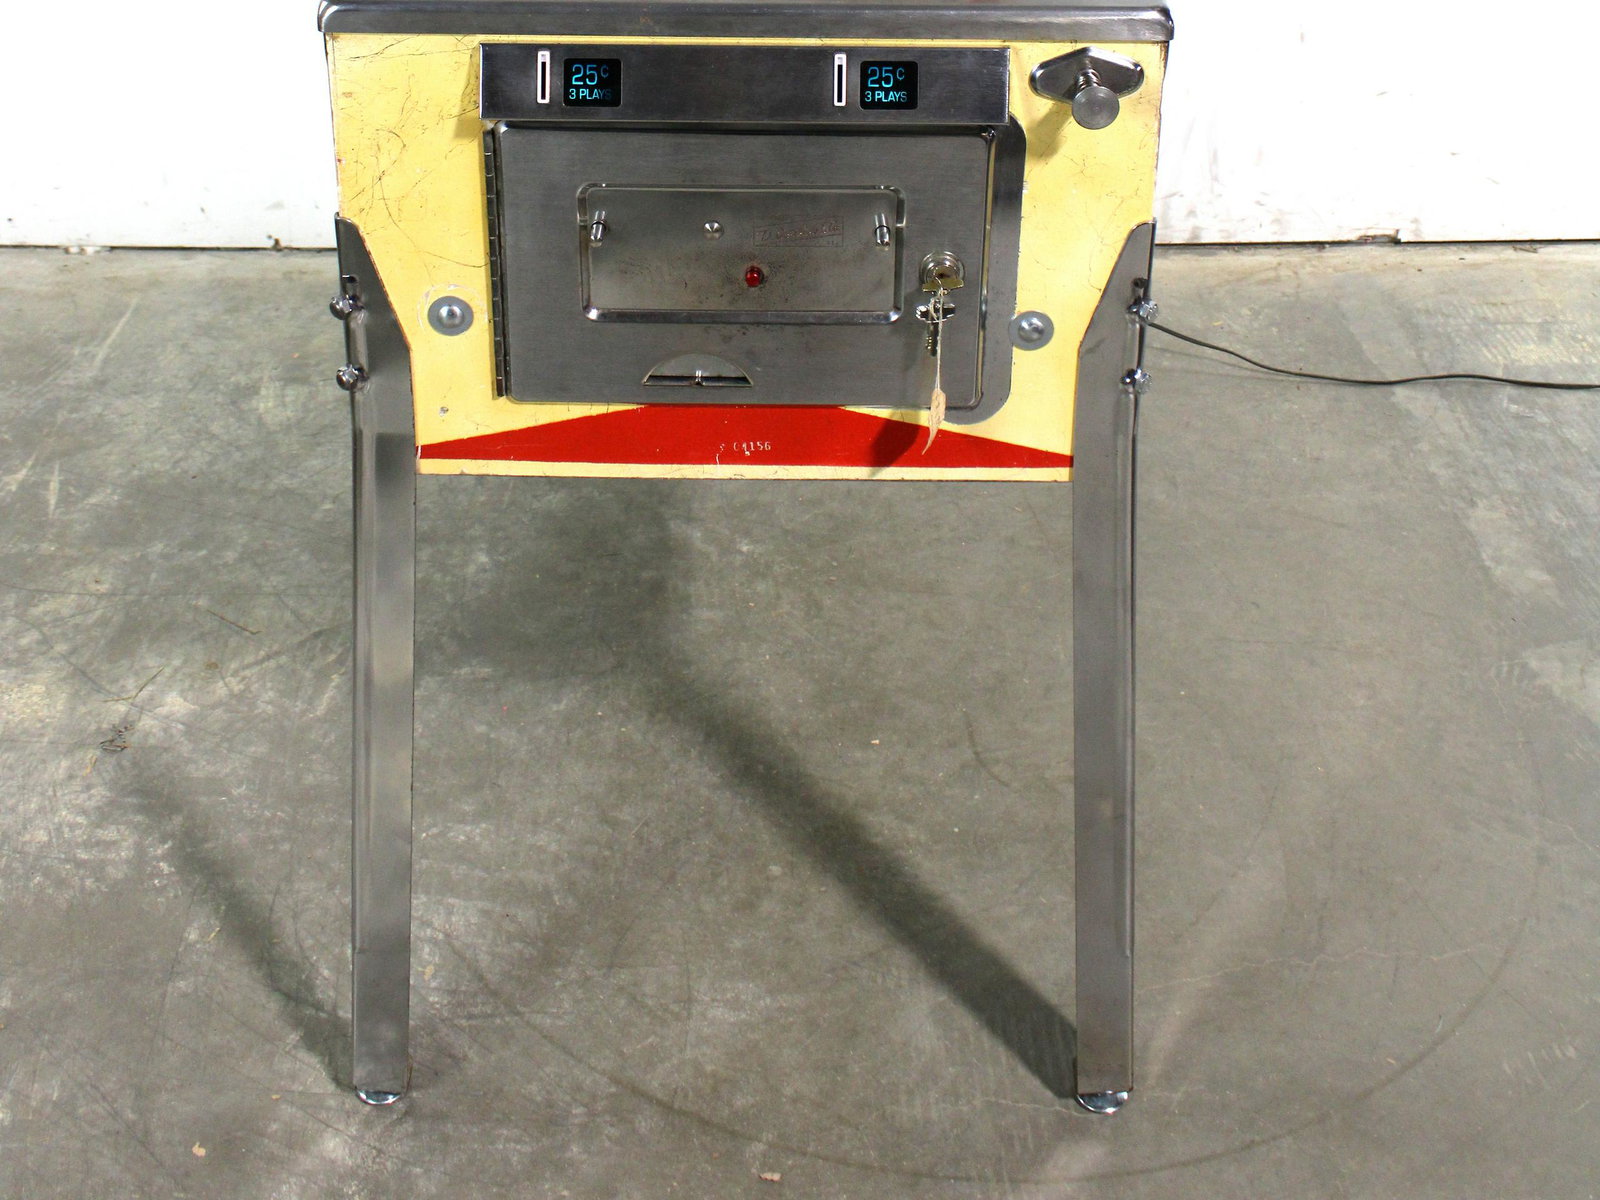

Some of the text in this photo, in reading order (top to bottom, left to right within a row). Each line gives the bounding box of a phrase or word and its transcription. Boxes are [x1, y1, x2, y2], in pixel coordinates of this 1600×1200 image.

[568, 88, 612, 100] 3 PLAYS
[864, 90, 907, 102] 3 PLAYS
